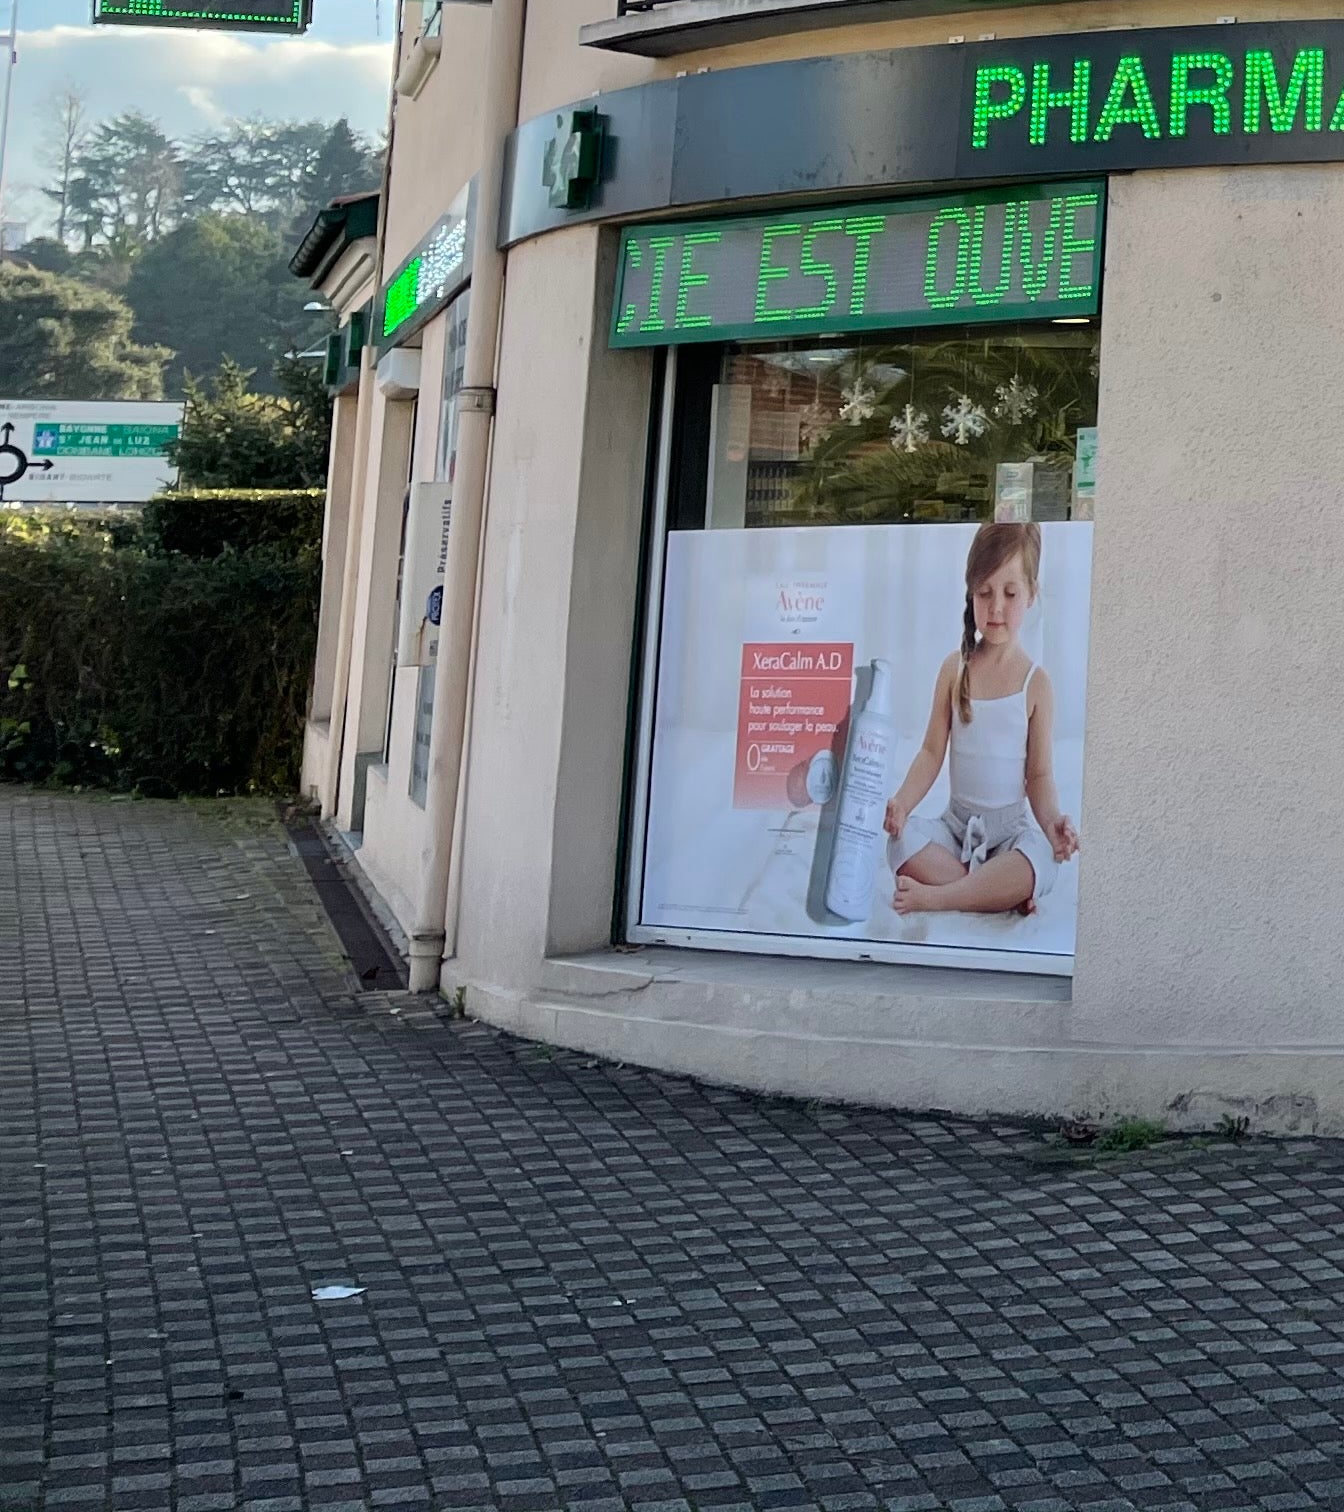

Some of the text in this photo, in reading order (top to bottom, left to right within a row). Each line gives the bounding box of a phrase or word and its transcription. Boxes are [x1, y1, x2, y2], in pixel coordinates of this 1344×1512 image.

[754, 216, 886, 323] EST
[924, 194, 1099, 309] OUVE
[78, 436, 109, 445] JEAN
[128, 436, 150, 445] LUZ
[437, 498, 452, 574] Préservatifs
[776, 590, 825, 612] Avène
[753, 651, 842, 671] XeraCalm A.D
[761, 686, 792, 699] solution
[749, 702, 825, 718] haute performance
[748, 722, 766, 734] pour
[768, 719, 803, 735] soulager
[805, 719, 814, 732] la
